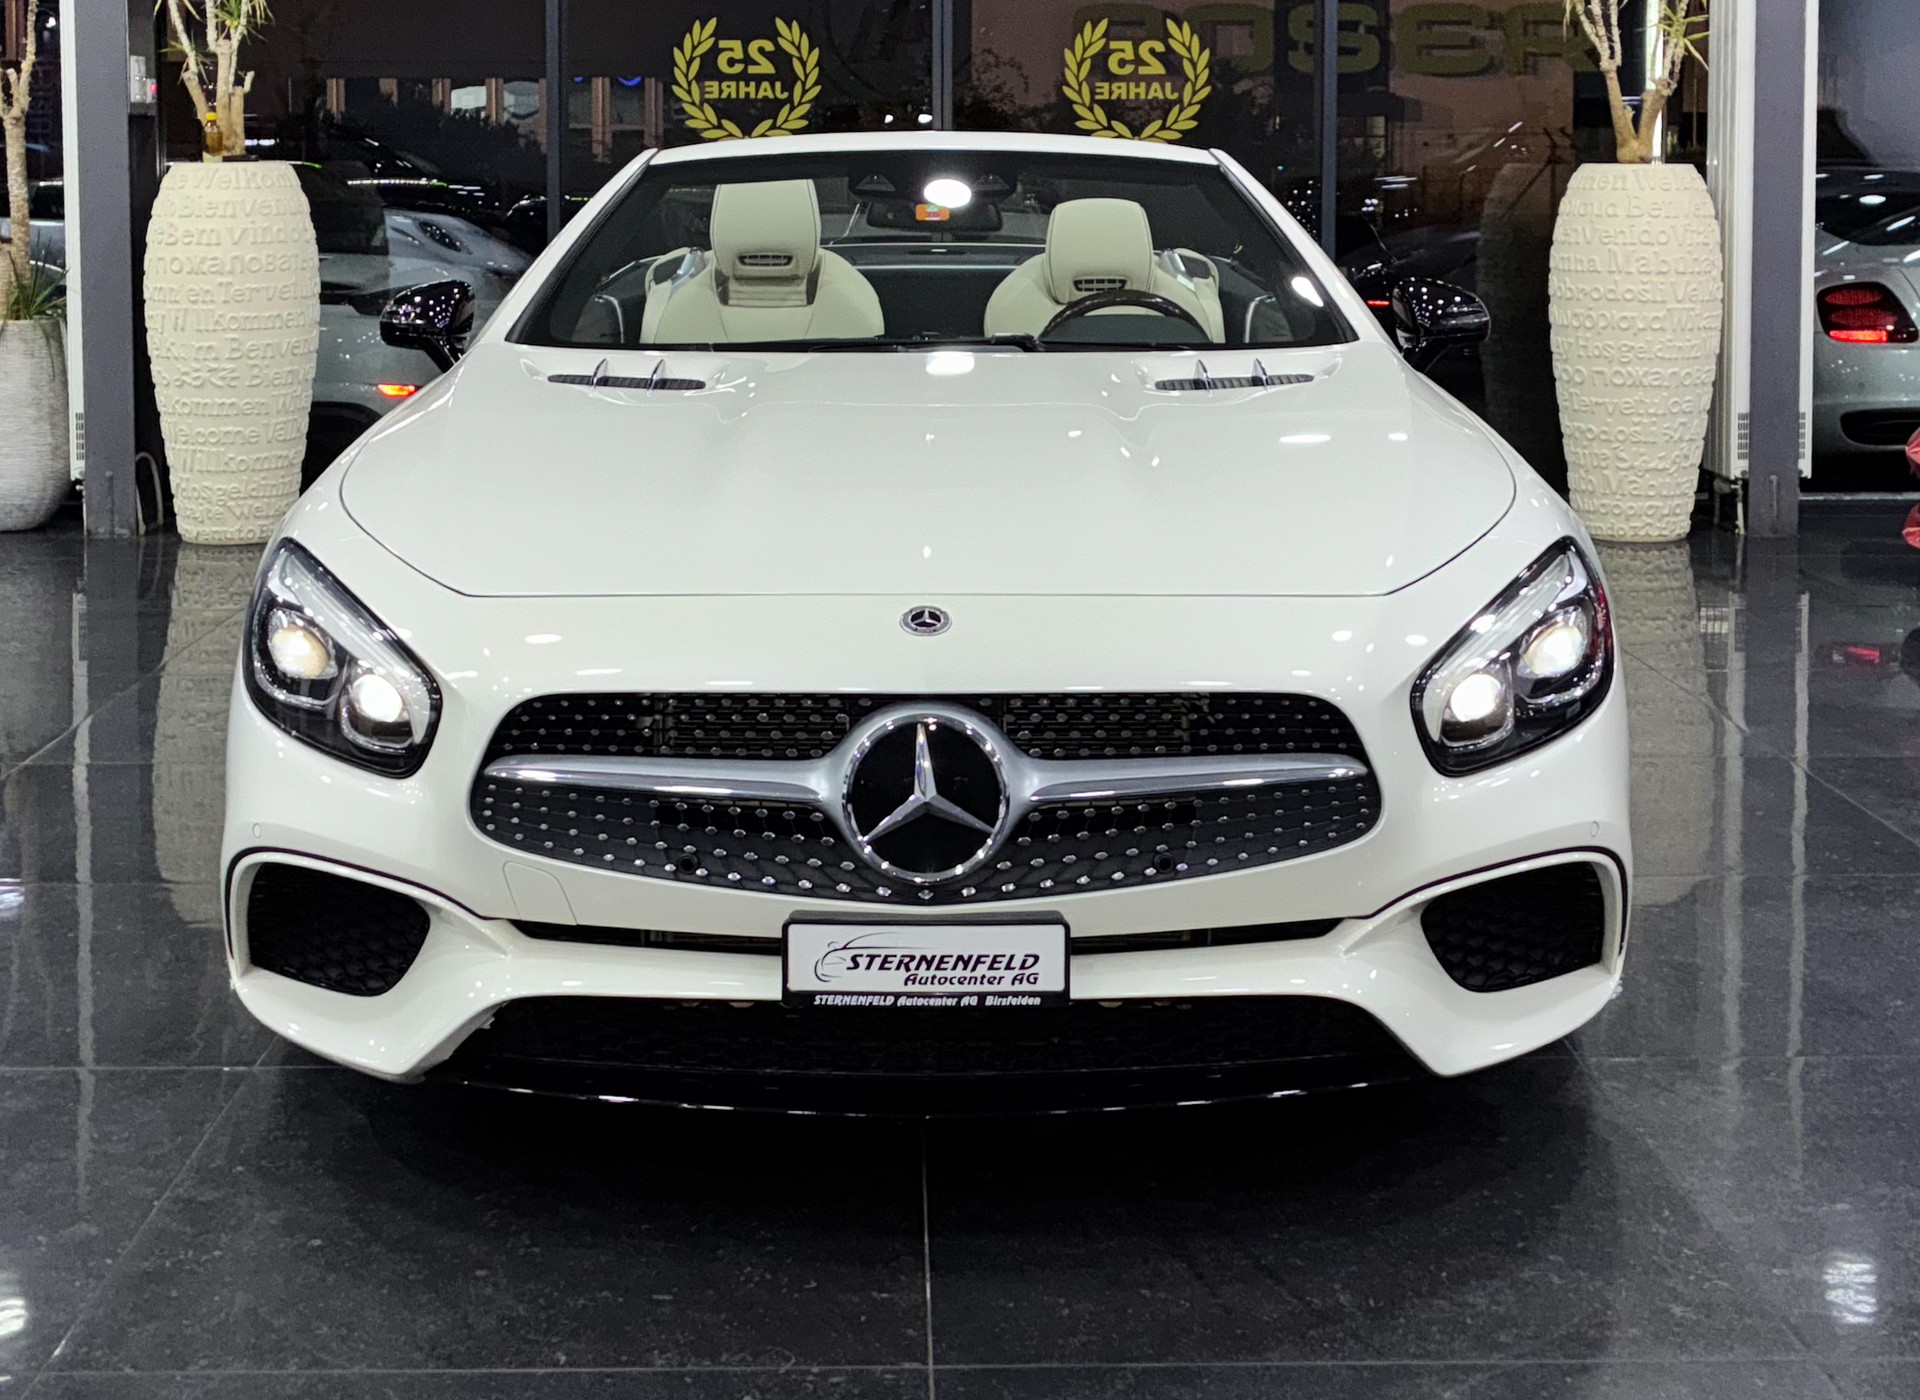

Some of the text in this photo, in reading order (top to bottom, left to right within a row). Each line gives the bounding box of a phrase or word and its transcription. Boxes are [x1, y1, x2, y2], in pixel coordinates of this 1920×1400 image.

[846, 953, 1040, 973] STERNENFELD
[904, 973, 1040, 987] Autocenter AG
[814, 995, 1041, 1007] STERNENFELD Autocenter AG Birsfelden
